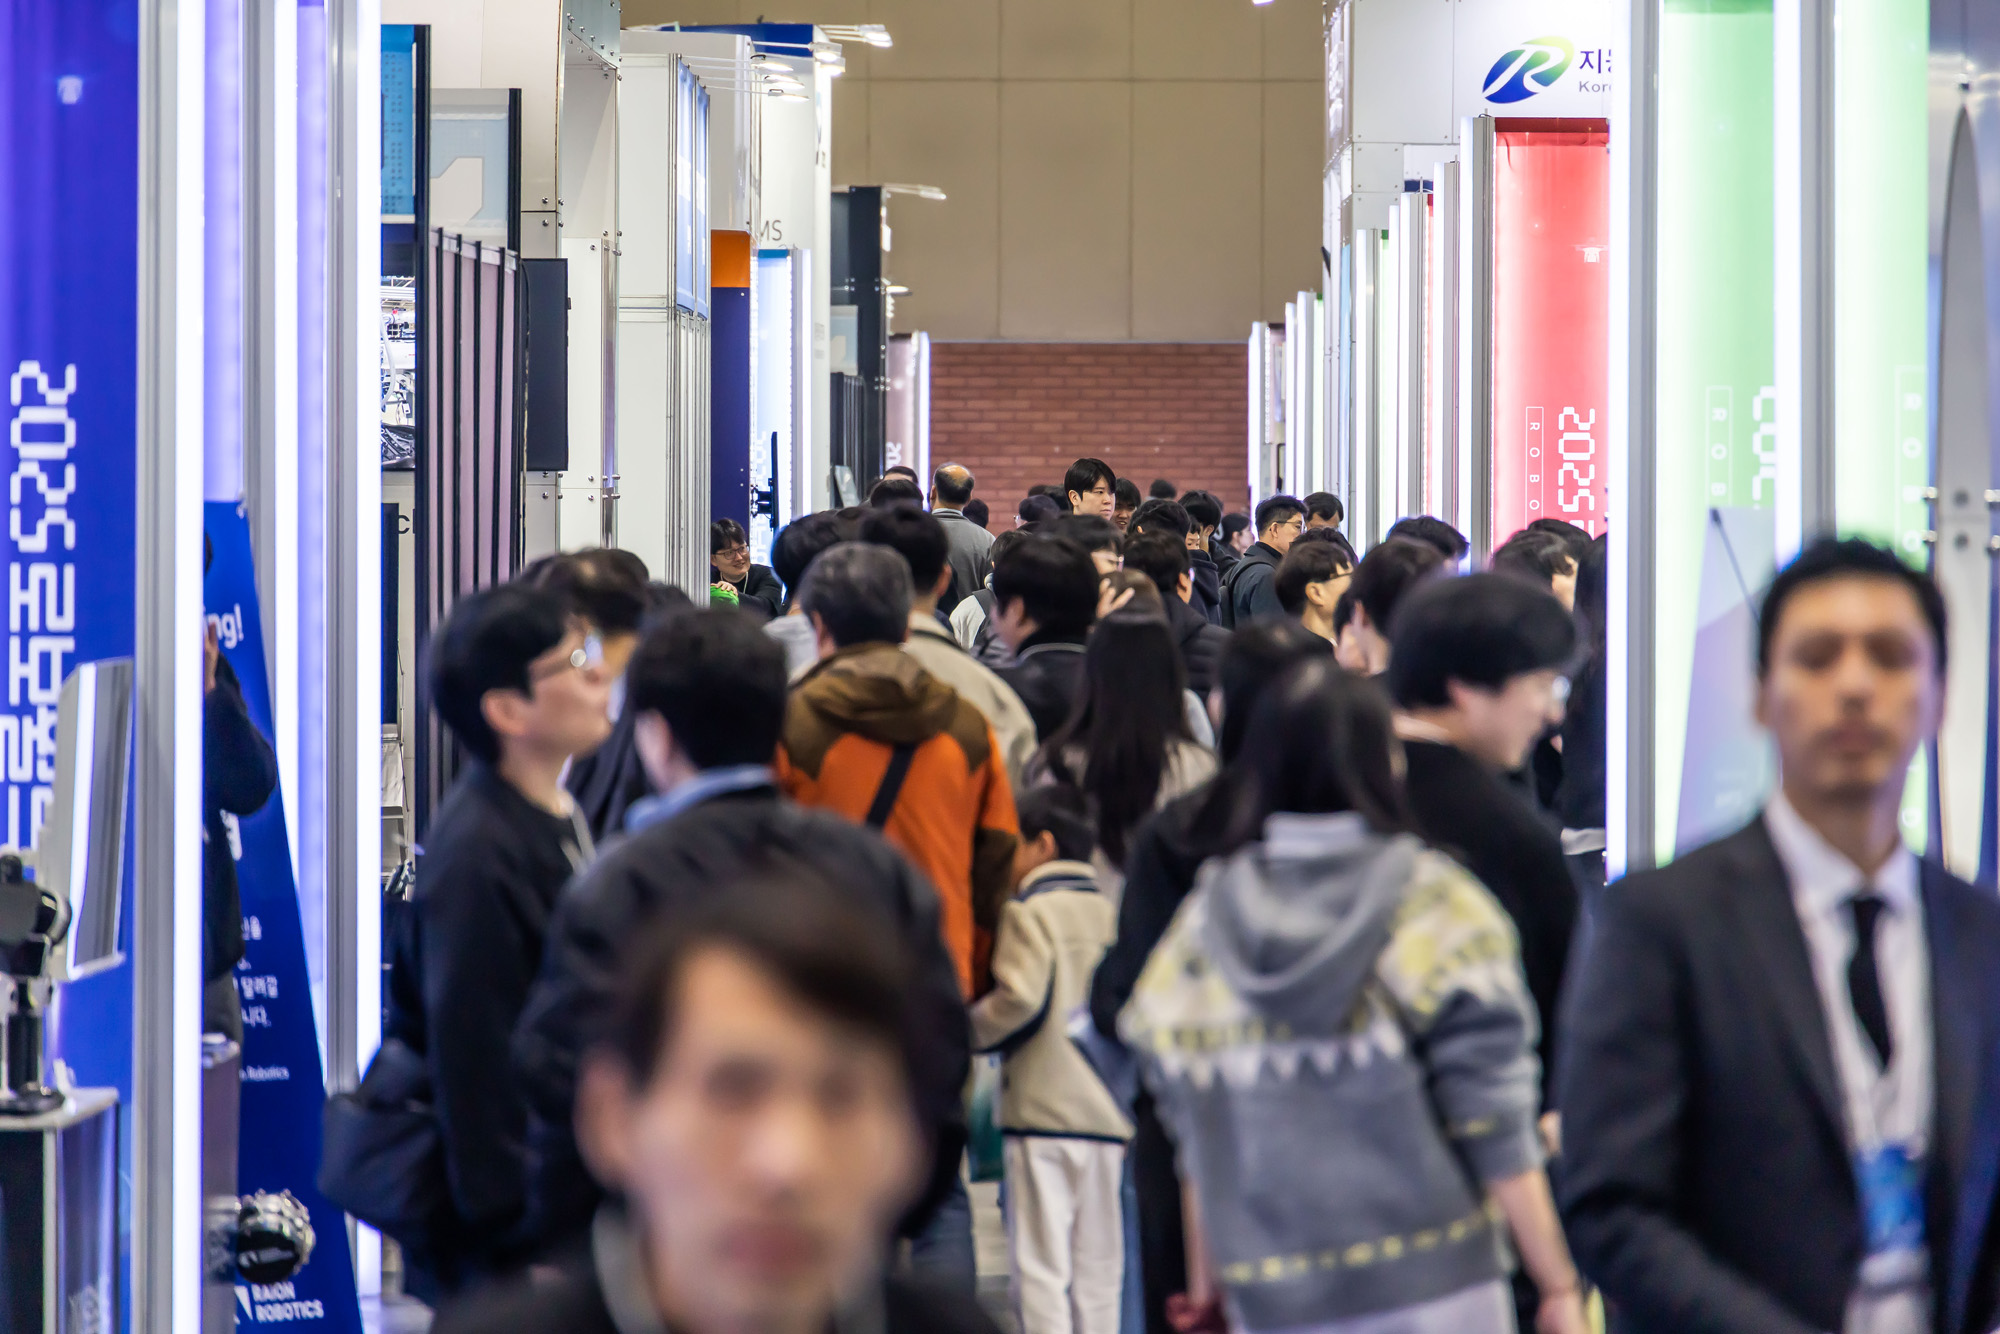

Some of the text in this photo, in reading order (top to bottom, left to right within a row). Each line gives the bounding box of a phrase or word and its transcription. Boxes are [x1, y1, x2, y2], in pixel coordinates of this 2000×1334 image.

[1579, 80, 1611, 93] Kor
[10, 360, 77, 553] 2025
[1529, 422, 1541, 511] ROBO
[1558, 406, 1595, 512] 2025
[1710, 407, 1728, 497] ROB
[204, 602, 244, 650] ng!
[255, 1298, 324, 1323] ROBOTICS
